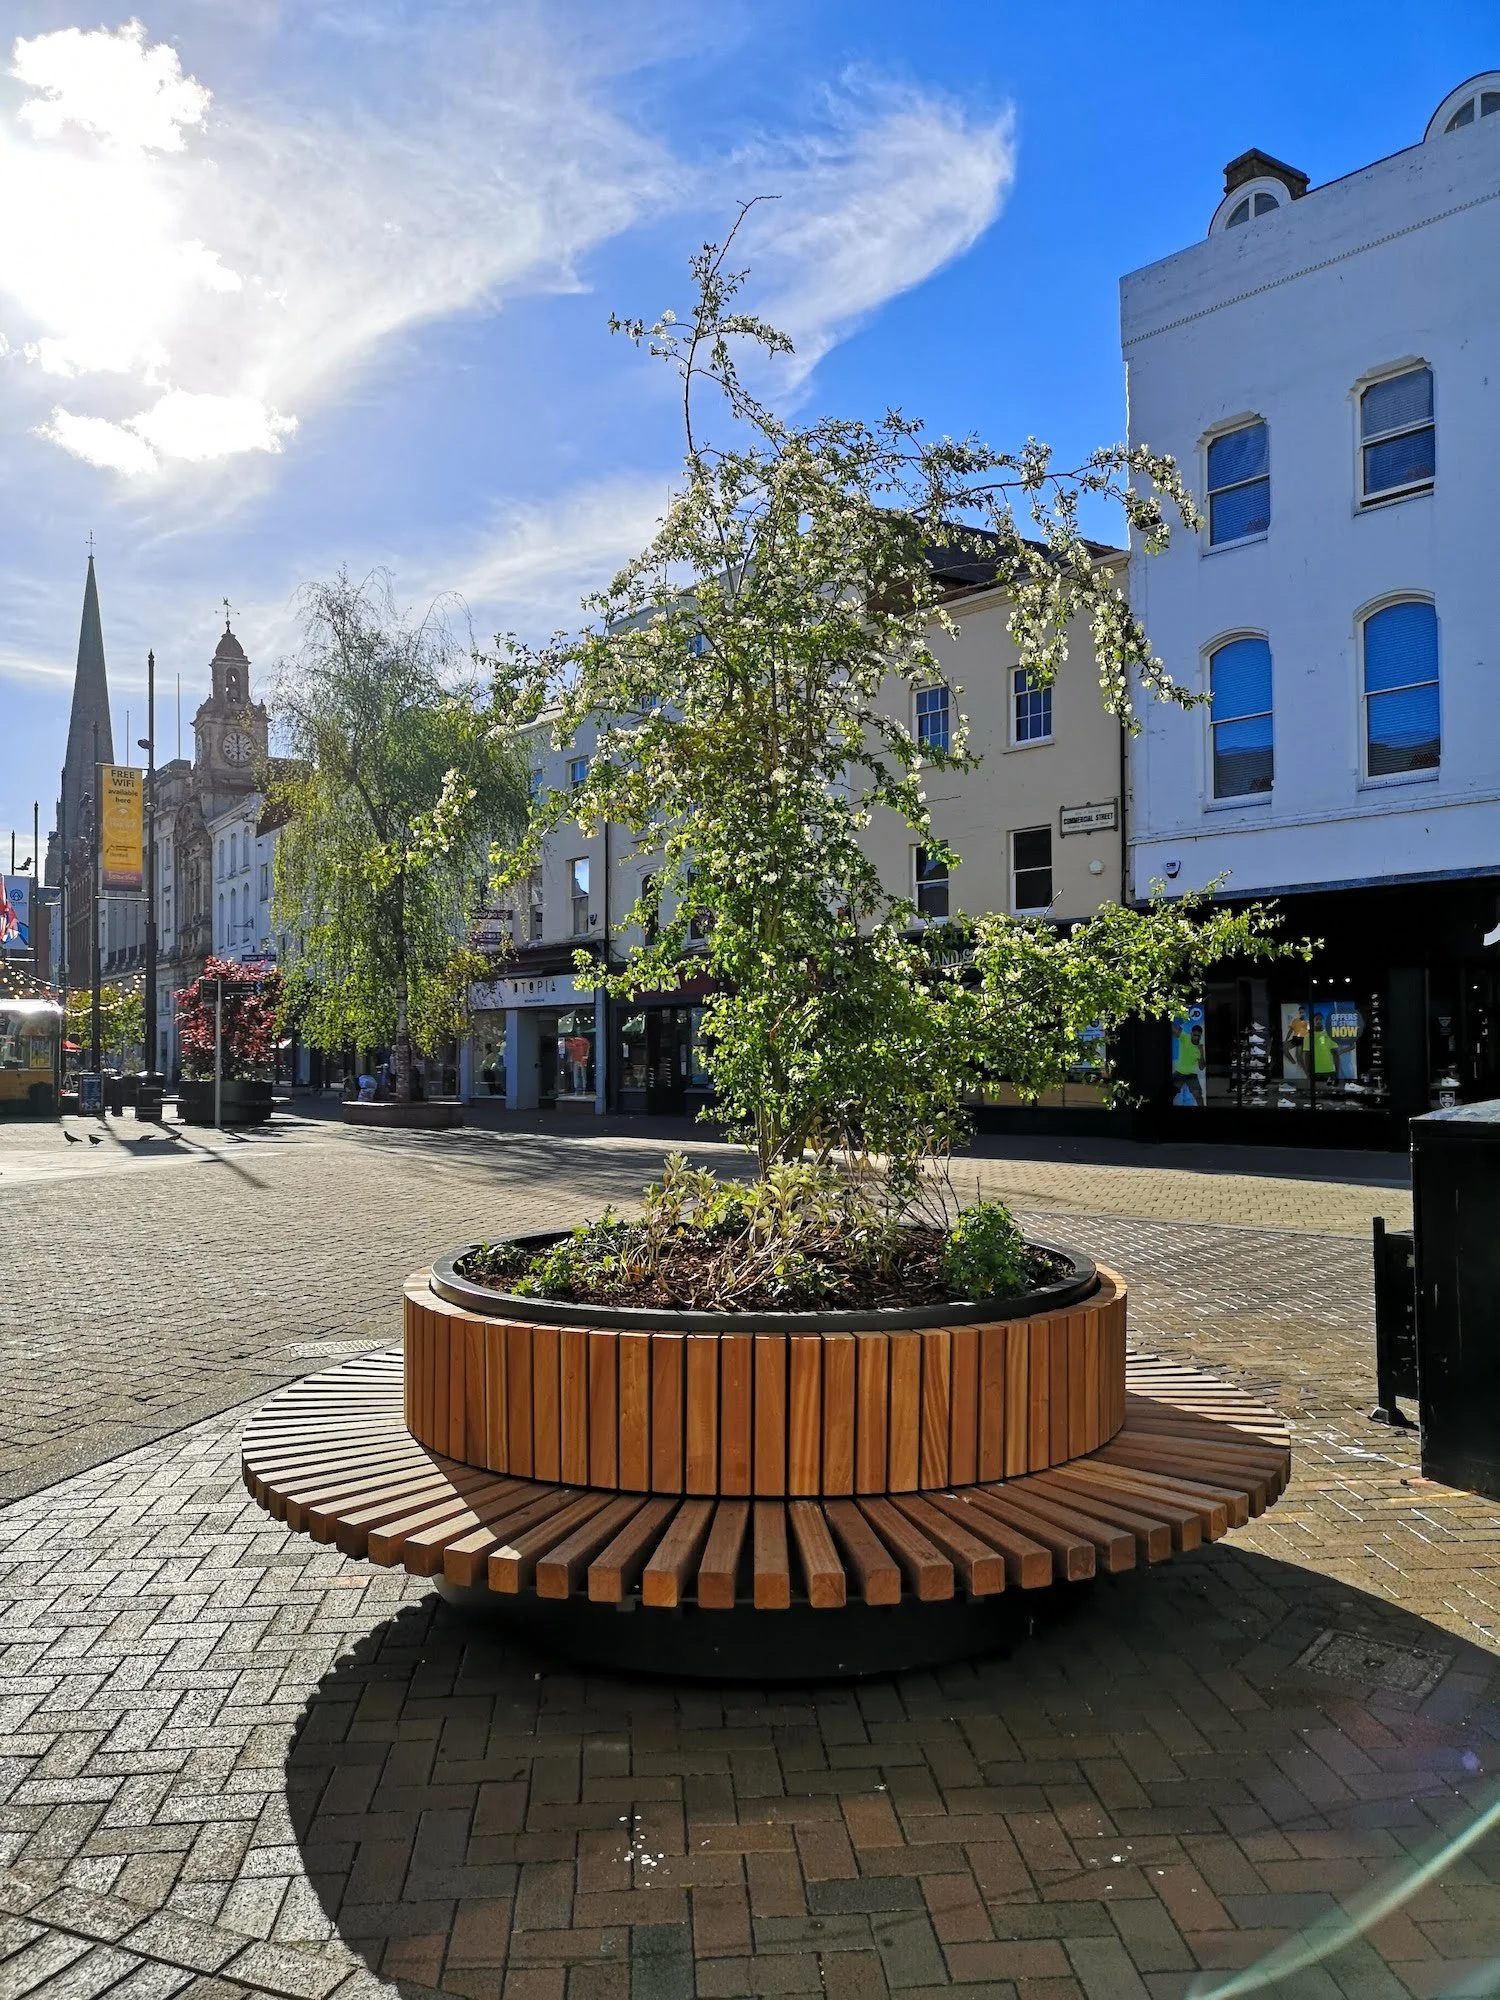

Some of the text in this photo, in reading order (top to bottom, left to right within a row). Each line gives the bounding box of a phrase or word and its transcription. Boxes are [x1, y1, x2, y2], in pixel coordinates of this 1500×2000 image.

[111, 769, 135, 779] FREE
[108, 788, 139, 797] available
[115, 796, 132, 804] here
[1063, 815, 1094, 825] COMMERCIAL
[1095, 812, 1114, 821] STREET
[1331, 1013, 1358, 1021] OFFERS
[1331, 1026, 1358, 1038] NOW
